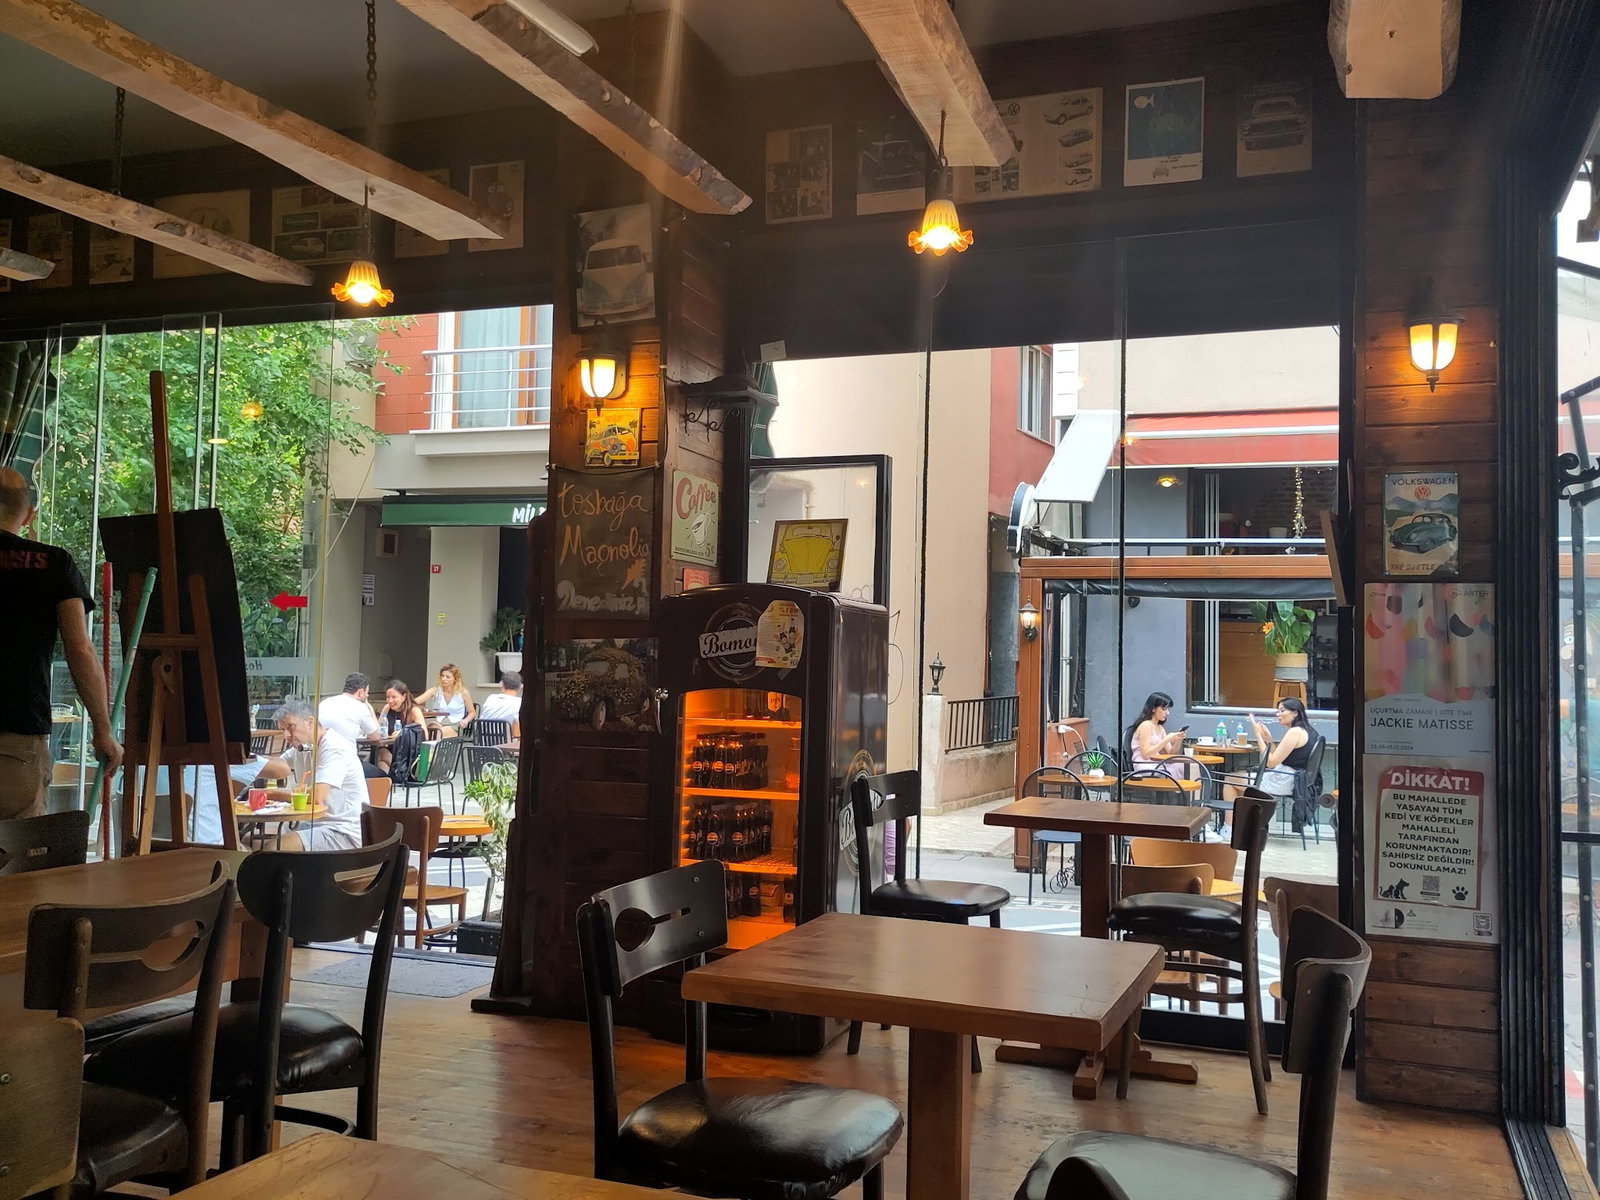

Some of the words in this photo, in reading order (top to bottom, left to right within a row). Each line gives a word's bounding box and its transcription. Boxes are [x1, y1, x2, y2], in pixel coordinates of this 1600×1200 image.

[1391, 477, 1456, 486] VOLKSWAGEN
[675, 477, 717, 520] Coffee
[559, 524, 650, 577] Magnolia
[1369, 707, 1404, 716] UÇURTMA
[1369, 717, 1414, 729] JACKIE
[1418, 718, 1474, 730] MATISSE
[1391, 769, 1470, 791] DİKKAT!
[1408, 794, 1467, 806] MAHALLEDE
[1396, 803, 1440, 814] YAŞAYAN
[1442, 806, 1463, 815] TÜM
[1384, 812, 1407, 820] KEDİ
[1424, 814, 1474, 826] KÖPEKLER
[1401, 823, 1456, 834] MAHALLELİ
[1398, 833, 1459, 844] TARAFINDAN
[1385, 842, 1472, 856] KORUNMAKTADIR!
[1382, 851, 1425, 861] SAHİPSİZ
[1427, 855, 1475, 866] DEĞİLDİR!
[1389, 861, 1467, 875] DOKUNULAMAZ!
